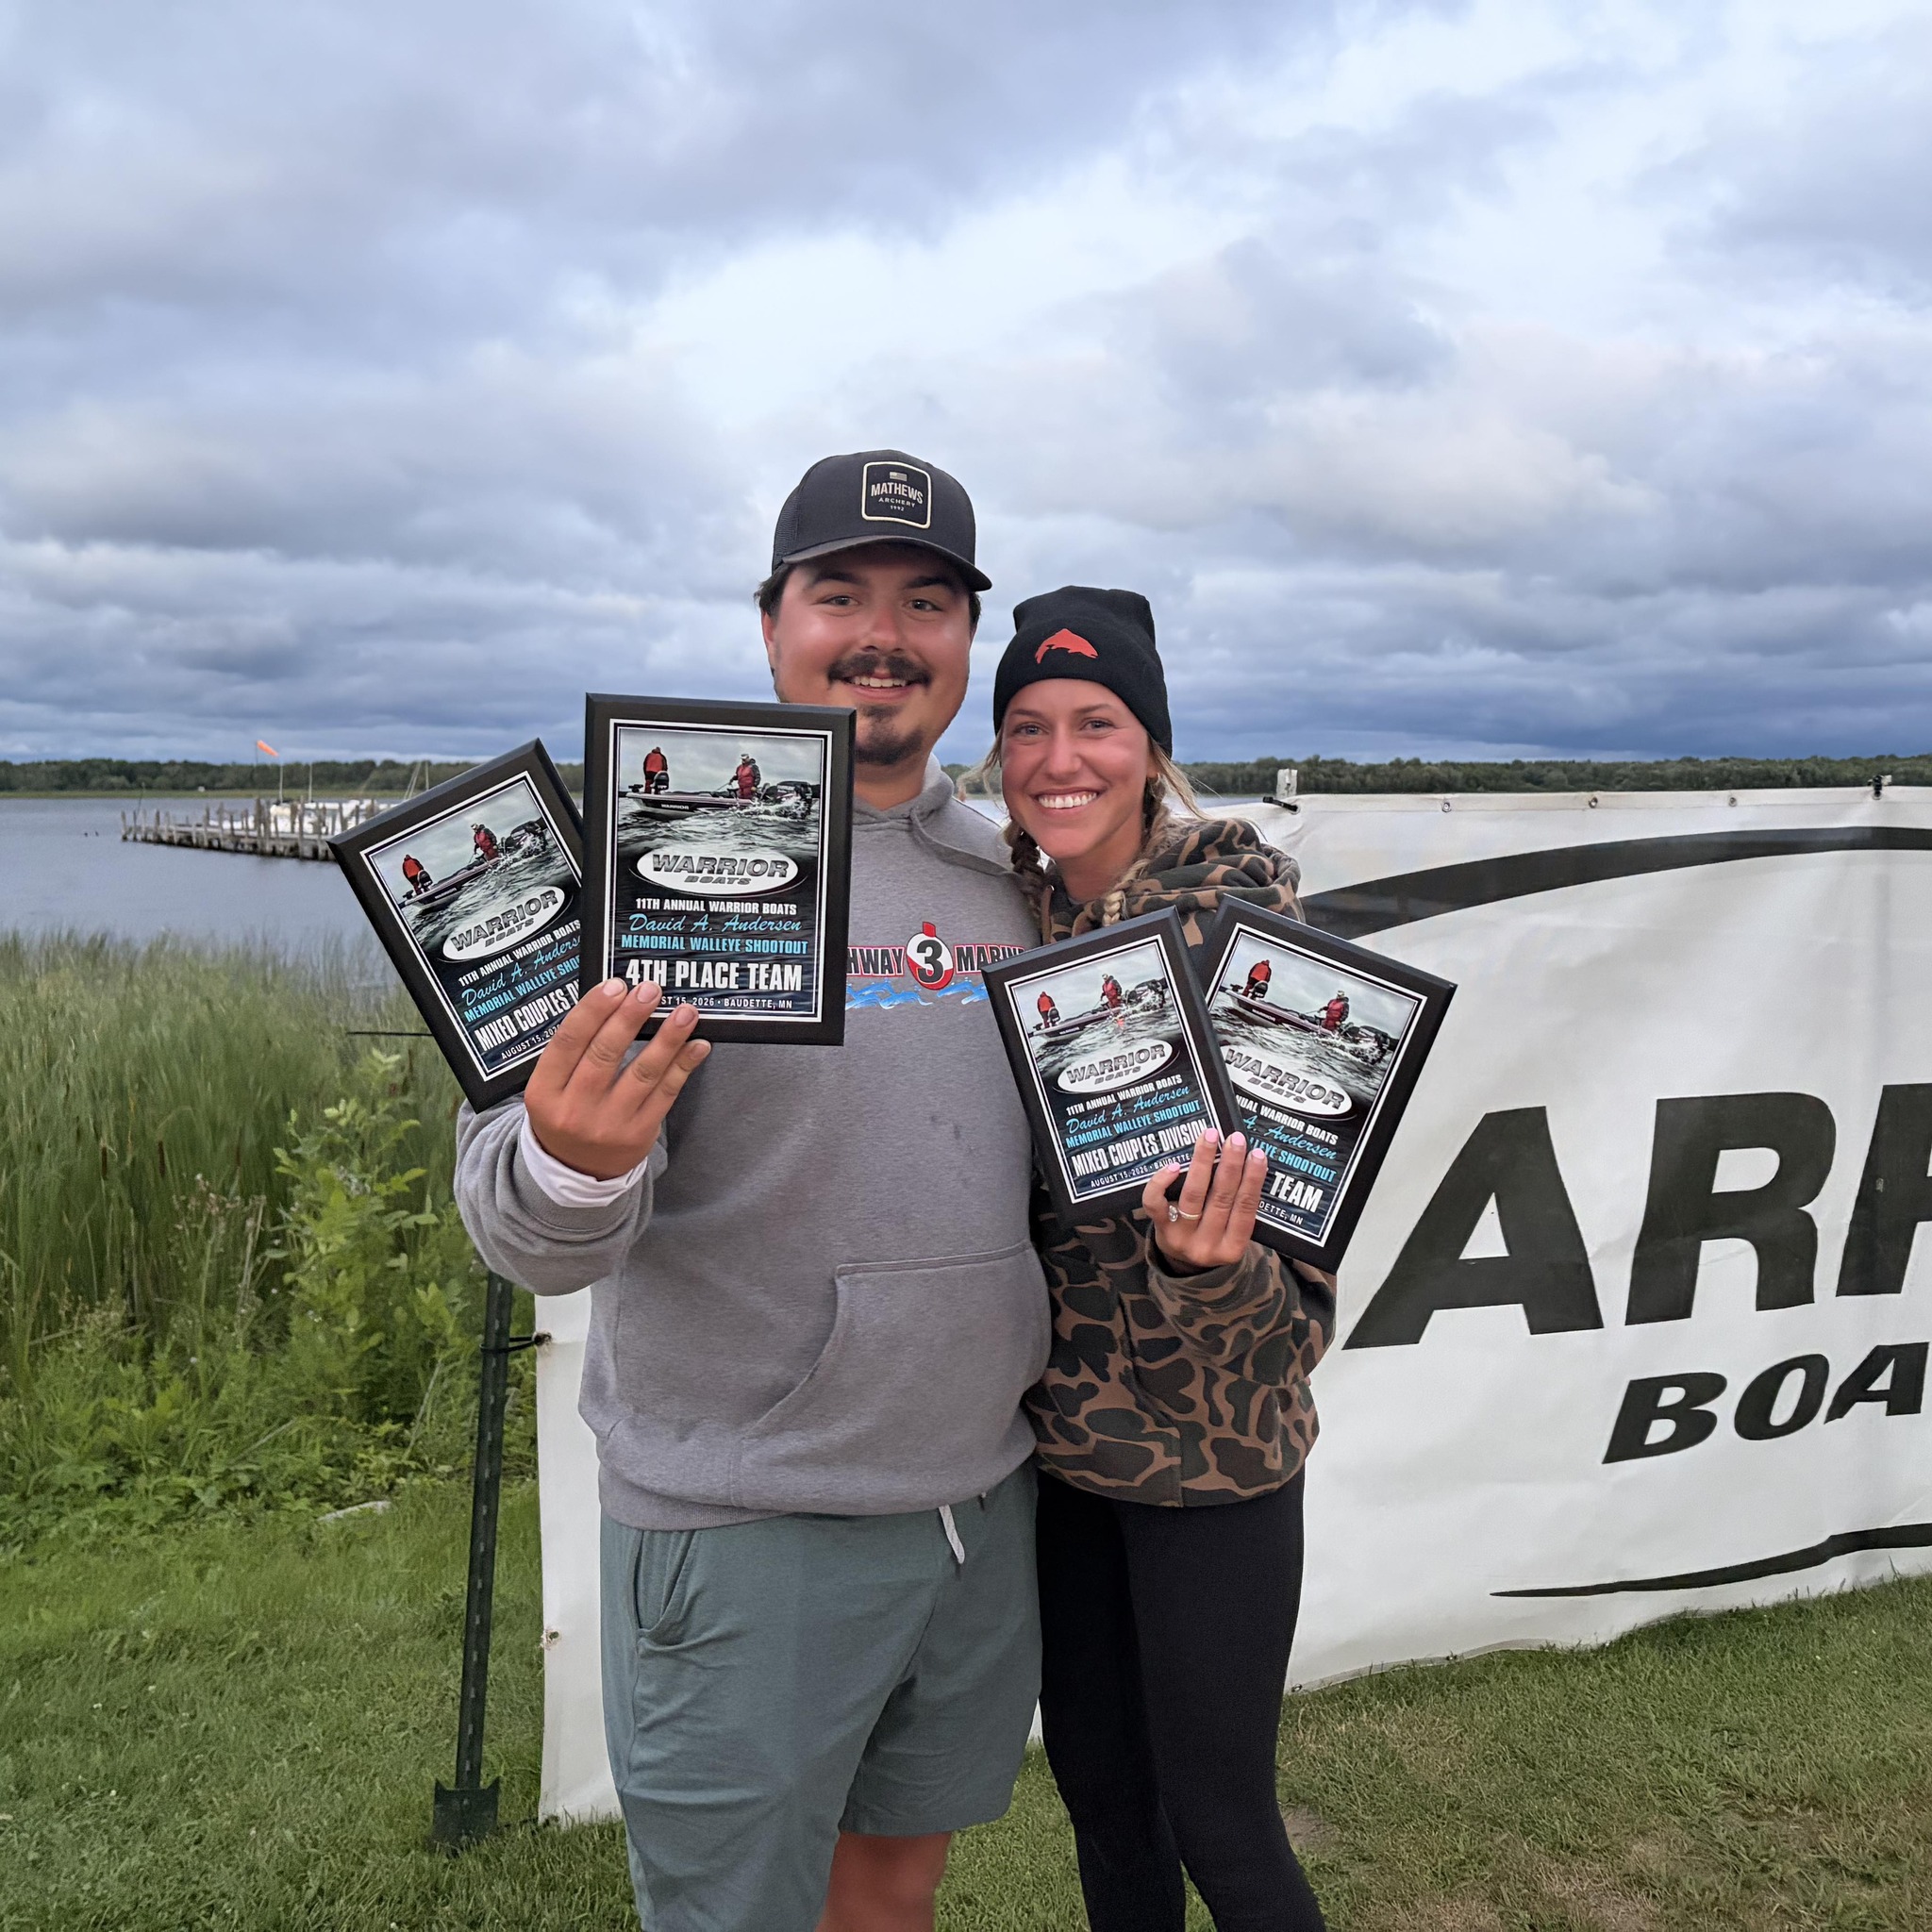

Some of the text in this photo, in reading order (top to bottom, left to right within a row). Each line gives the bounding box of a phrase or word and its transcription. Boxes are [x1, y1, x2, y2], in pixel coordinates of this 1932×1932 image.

[871, 482, 924, 504] MATHEWS
[878, 497, 915, 508] ARCHERY
[653, 855, 789, 877] WARRIOR
[685, 875, 751, 885] BOATS
[451, 890, 558, 952] WARRIOR
[628, 913, 802, 932] David A. Andersen
[636, 898, 797, 915] 11TH ANNUAL WARRIOR BOATS
[485, 918, 535, 947] BOATS
[621, 934, 808, 955] MEMORIAL WALLEYE SHOOTOUT
[458, 919, 581, 987] 11TH ANNUAL WARRIOR BOATS
[917, 939, 943, 984] 3
[461, 972, 507, 1006] David
[511, 962, 527, 983] A.
[625, 958, 802, 991] 4TH PLACE TEAM
[464, 990, 516, 1023] MEMORIAL
[515, 970, 557, 996] WALLEYE
[675, 996, 688, 1006] 15
[692, 997, 715, 1007] 2026
[724, 998, 775, 1009] BAUDETTE,
[778, 1000, 792, 1009] MN
[474, 1015, 519, 1052] MIXED
[513, 988, 572, 1032] COUPLES
[501, 1040, 531, 1060] AUGUST
[1066, 1044, 1166, 1084] WARRIOR
[1094, 1066, 1141, 1085] BOATS
[1224, 1048, 1345, 1109] WARRIOR
[1247, 1076, 1307, 1104] BOATS
[1066, 1074, 1183, 1116] 11TH ANNUAL WARRIOR BOATS
[1066, 1086, 1191, 1134] David A. Andersen
[1066, 1100, 1201, 1149] MEMORIAL WALLEYE SHOOTOUT
[1260, 1106, 1306, 1132] WARRIOR
[1306, 1124, 1339, 1145] BOATS
[1264, 1124, 1338, 1159] Andersen
[1072, 1119, 1208, 1177] MIXED COUPLES DIVISION
[1091, 1174, 1118, 1188] AUGUST
[1132, 1165, 1149, 1175] 2026
[1278, 1149, 1338, 1183] SHOOTOUT
[1270, 1172, 1324, 1213] TEAM
[1289, 1213, 1304, 1224] MN
